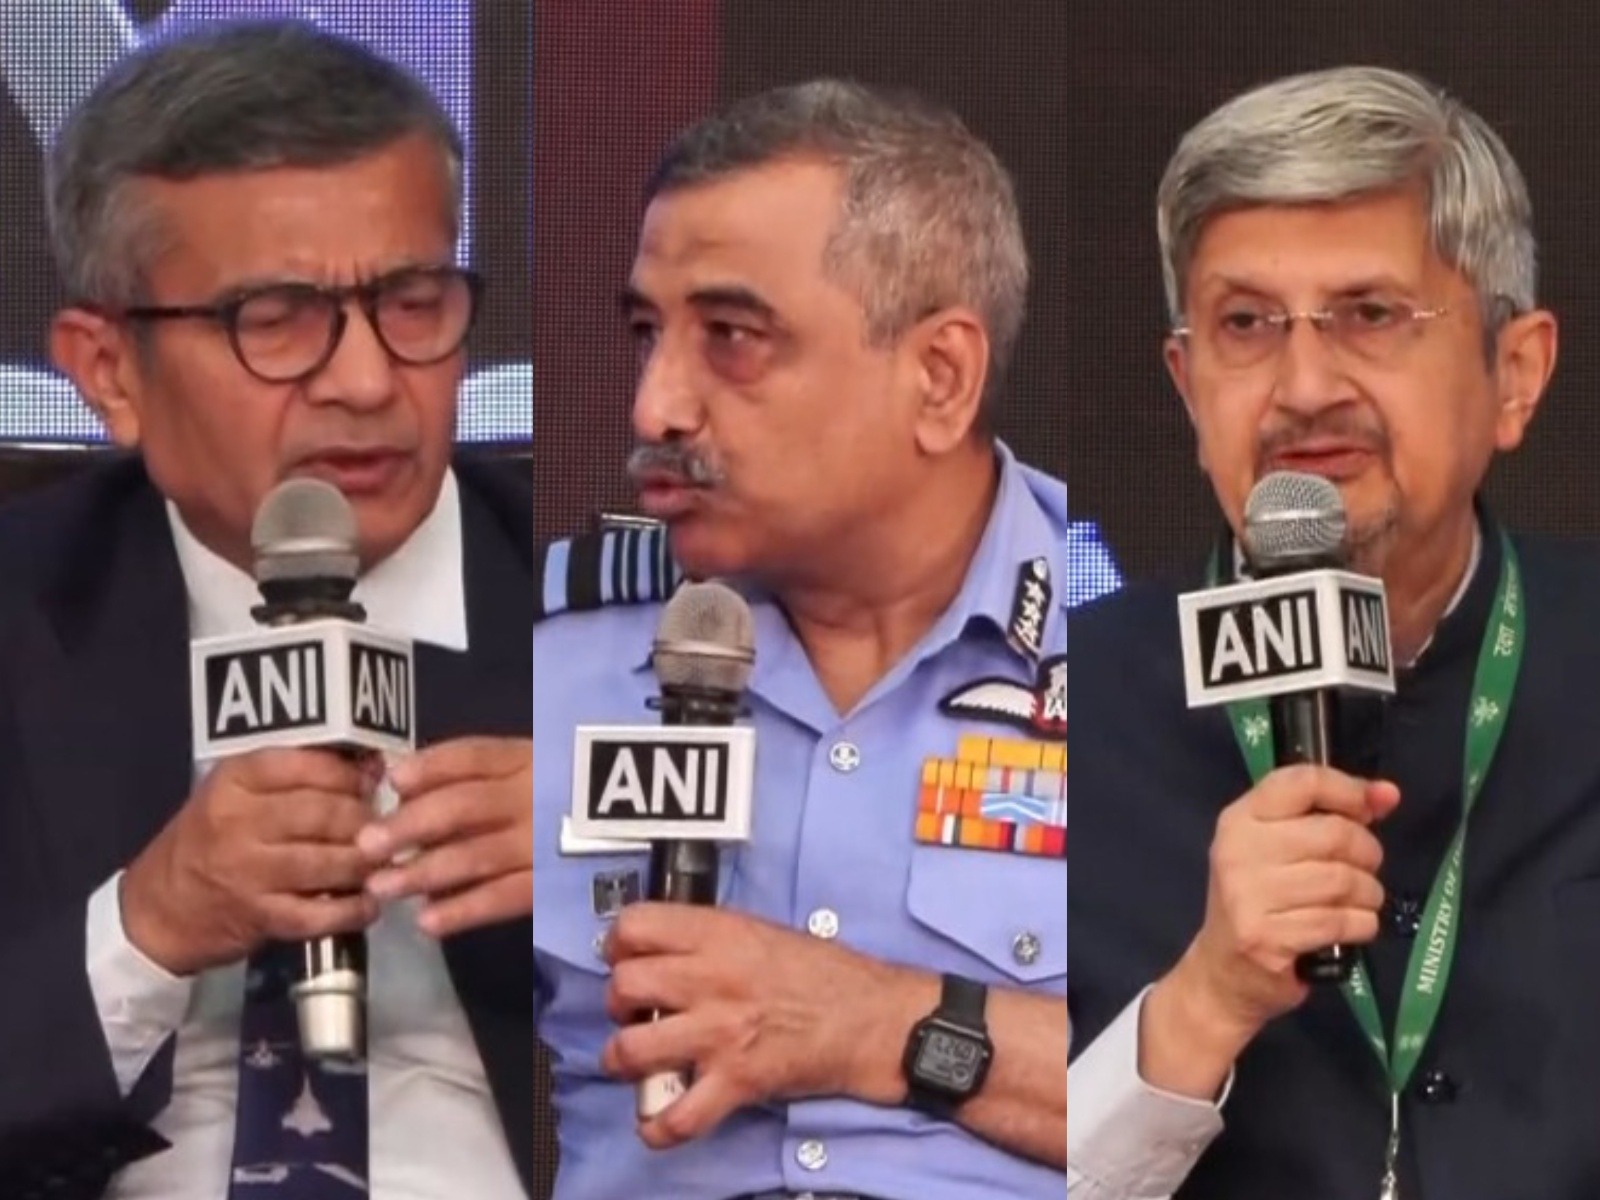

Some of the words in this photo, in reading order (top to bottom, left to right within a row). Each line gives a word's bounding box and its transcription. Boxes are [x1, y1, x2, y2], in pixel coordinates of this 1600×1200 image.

[1209, 596, 1315, 682] ANI
[1349, 595, 1387, 669] ANI
[215, 647, 320, 733] ANI
[355, 650, 408, 732] ANI
[596, 746, 720, 816] ANI
[1416, 896, 1454, 994] MINISTRY
